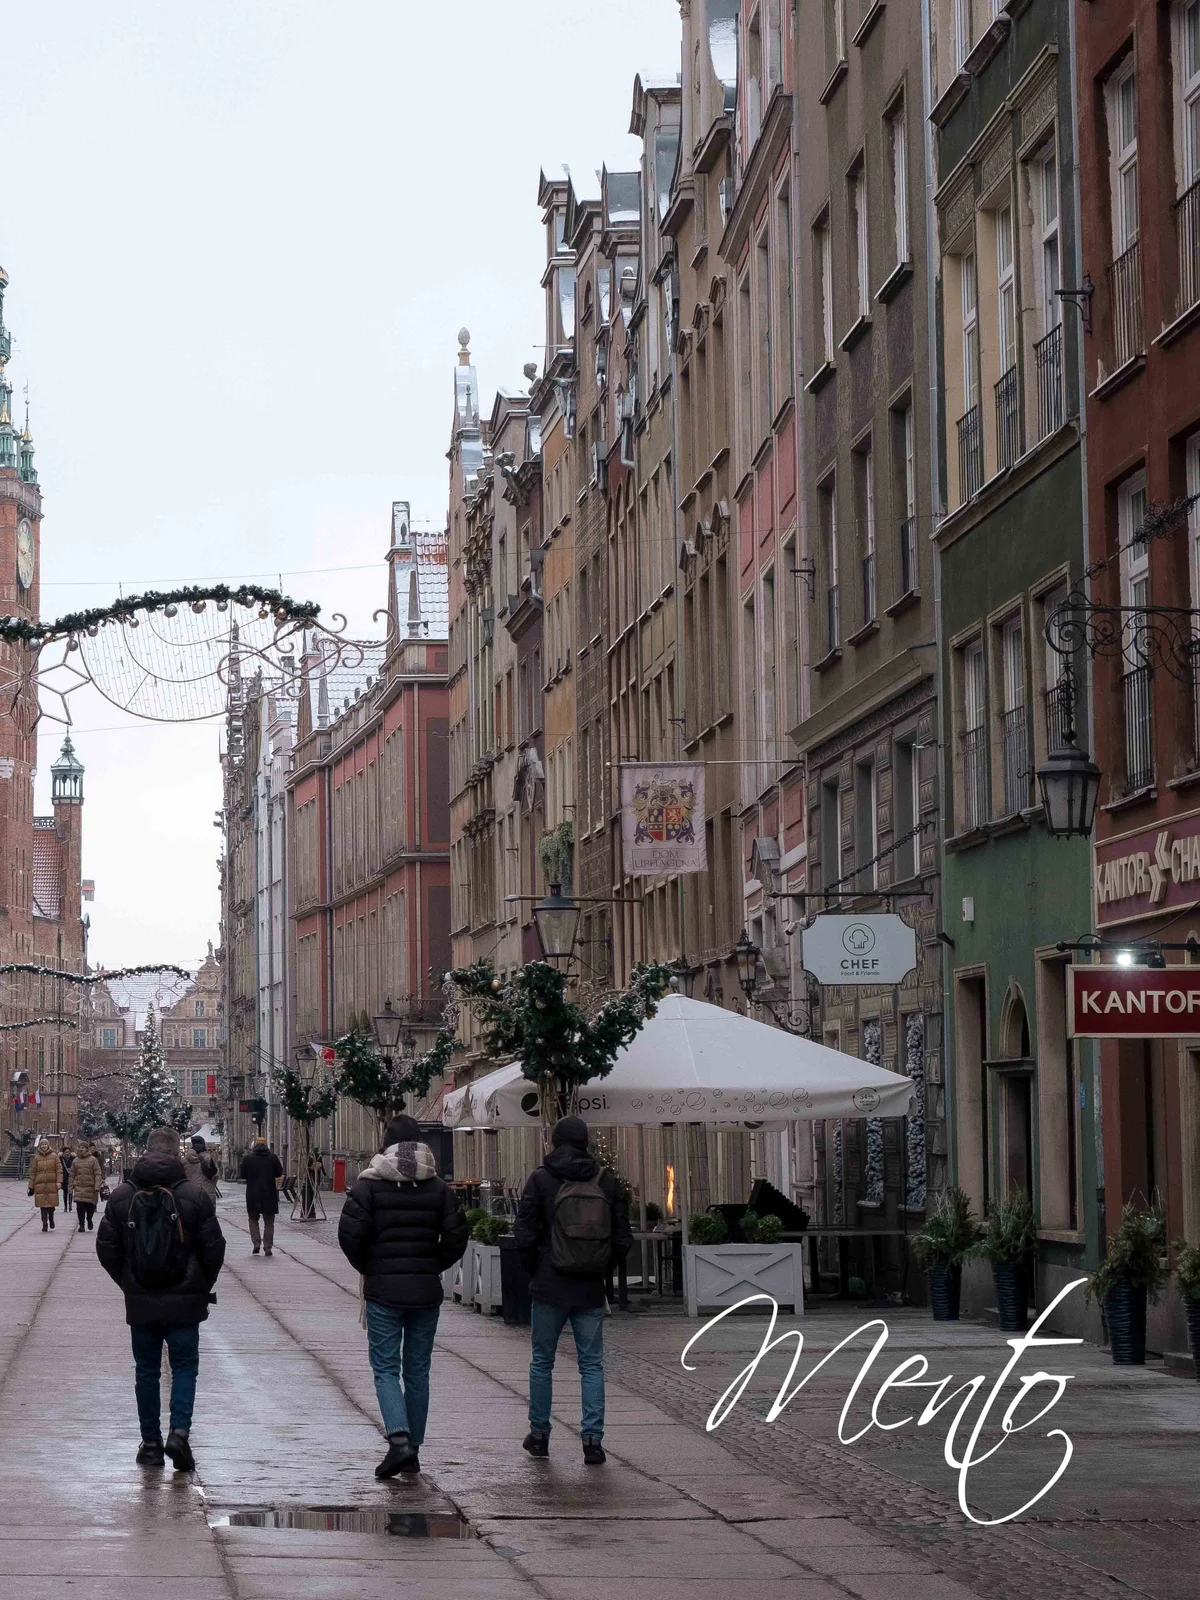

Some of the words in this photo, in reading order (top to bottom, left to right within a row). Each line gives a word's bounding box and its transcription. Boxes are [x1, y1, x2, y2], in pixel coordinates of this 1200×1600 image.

[652, 850, 679, 859] DOM
[634, 859, 699, 868] UPHAGENA
[1097, 851, 1150, 904] KANTOR
[840, 959, 879, 970] CHEF
[1082, 990, 1200, 1014] KANTOR
